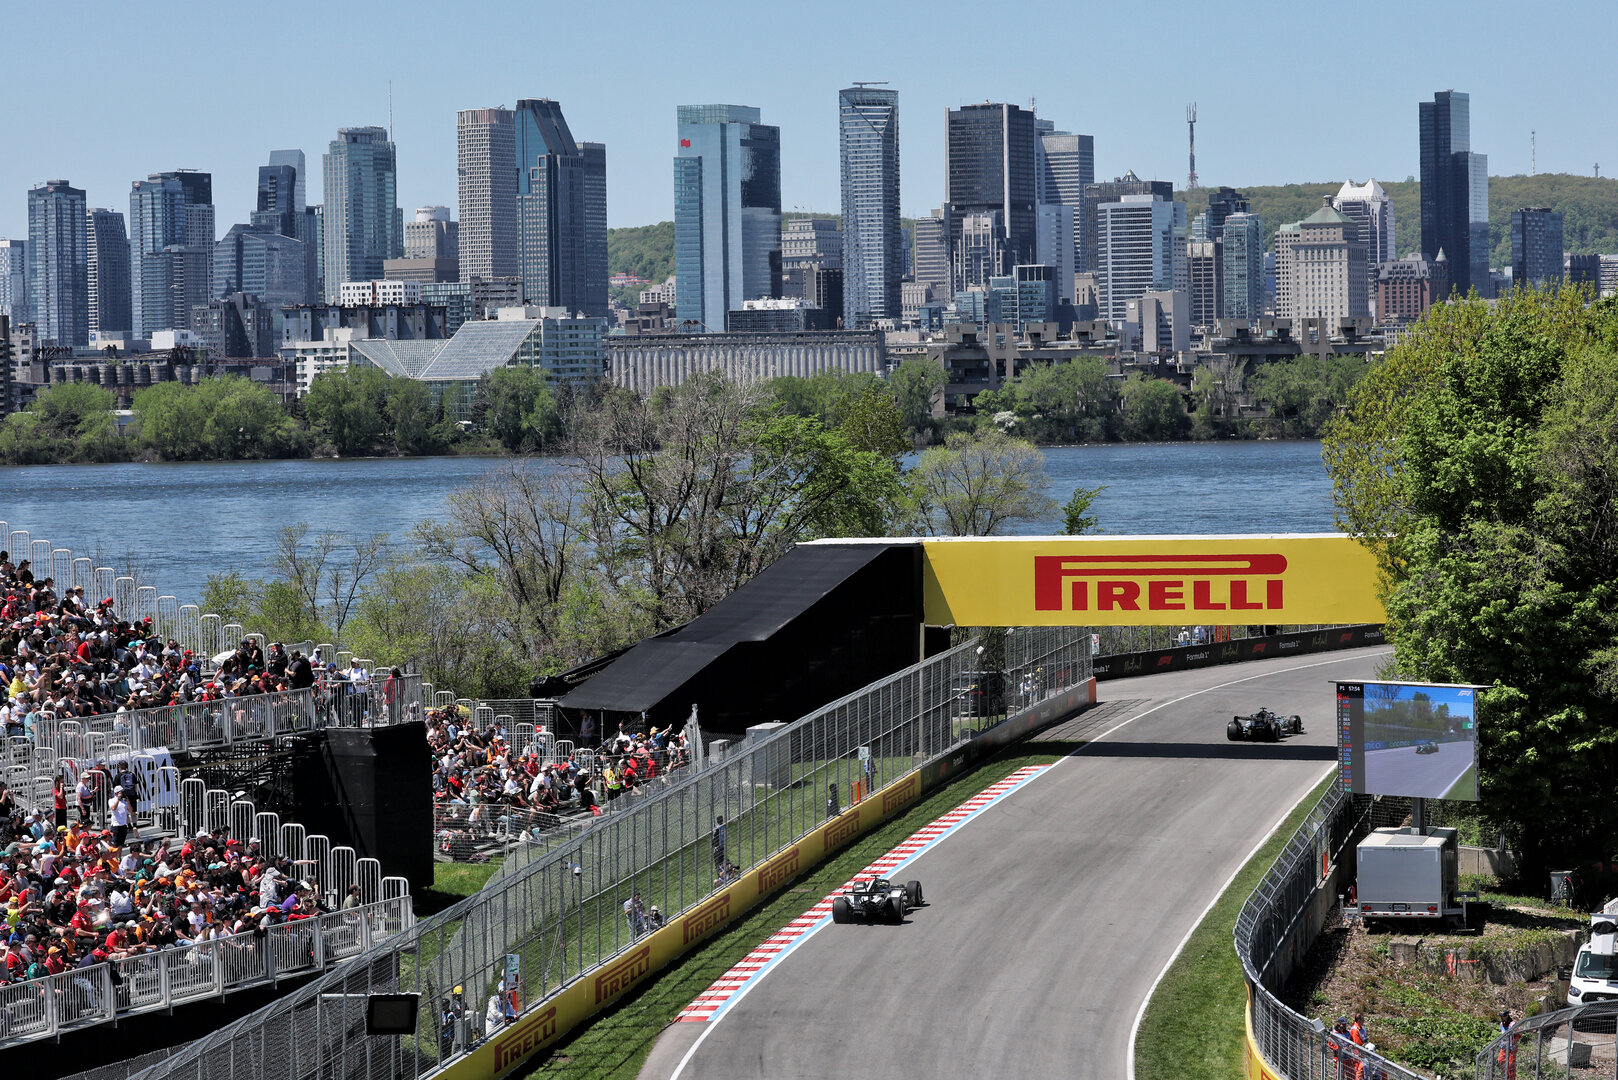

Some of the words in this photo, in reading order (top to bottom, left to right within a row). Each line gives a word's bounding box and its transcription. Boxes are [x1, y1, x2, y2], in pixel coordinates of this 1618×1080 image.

[1035, 554, 1287, 611] PIRELLI
[882, 778, 915, 814] PIRELLI
[824, 810, 860, 851] PIRELLI
[758, 848, 799, 895] PIRELLI
[683, 892, 730, 946] PIRELLI
[594, 945, 650, 1005] PIRELLI
[494, 1005, 557, 1075] PIRELLI
